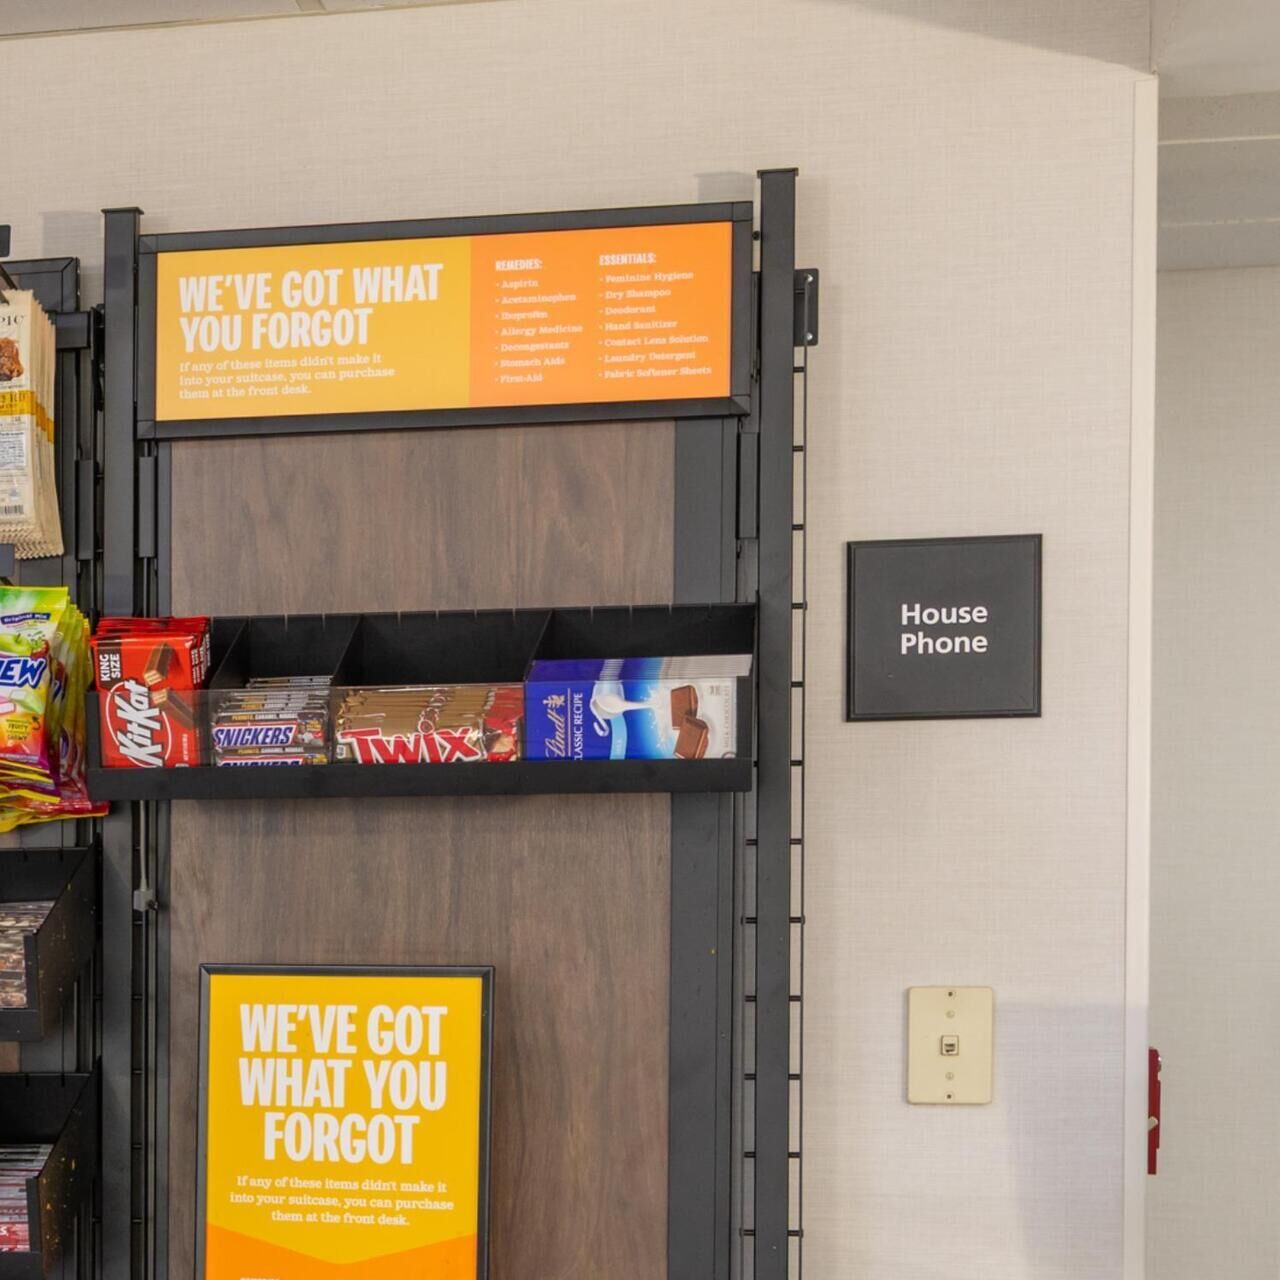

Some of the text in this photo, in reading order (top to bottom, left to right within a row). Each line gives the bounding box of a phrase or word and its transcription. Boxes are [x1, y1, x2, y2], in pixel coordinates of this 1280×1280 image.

[495, 259, 543, 271] REMEDIES:
[599, 252, 656, 266] ESSENTIALS:
[501, 280, 538, 290] Aspirin
[605, 271, 694, 283] Feminine Hygiene
[179, 263, 444, 313] WE'VE GOT WHAT
[605, 288, 671, 300] Dry Shampoo
[501, 293, 576, 305] Acetaminophen
[605, 304, 656, 316] Deodorant
[179, 307, 374, 353] YOU FORGOT
[501, 324, 583, 338] Allergy Medicine
[605, 319, 677, 331] Hand Sanitizer
[604, 334, 709, 347] Contact Lens Solution
[180, 353, 381, 374] If any of these items didn't make it
[500, 356, 565, 368] Stomach Aids
[604, 351, 696, 364] Laundry Detergent
[180, 367, 395, 387] into your suitcase, you can purchase
[179, 383, 312, 399] them at the front desk.
[901, 603, 988, 625] House
[901, 631, 988, 655] Phone
[100, 653, 110, 682] KING
[110, 653, 121, 679] SIZE
[214, 727, 294, 747] SNICKERS
[544, 708, 566, 758] Lindt
[240, 1003, 448, 1056] WE'VE GOT
[239, 1057, 447, 1111] WHAT YOU
[264, 1111, 420, 1165] FORGOT
[237, 1175, 447, 1193] If any of these items didn't make it
[230, 1192, 454, 1211] into your suitcase, you can purchase
[271, 1210, 410, 1226] them at the front desk.
